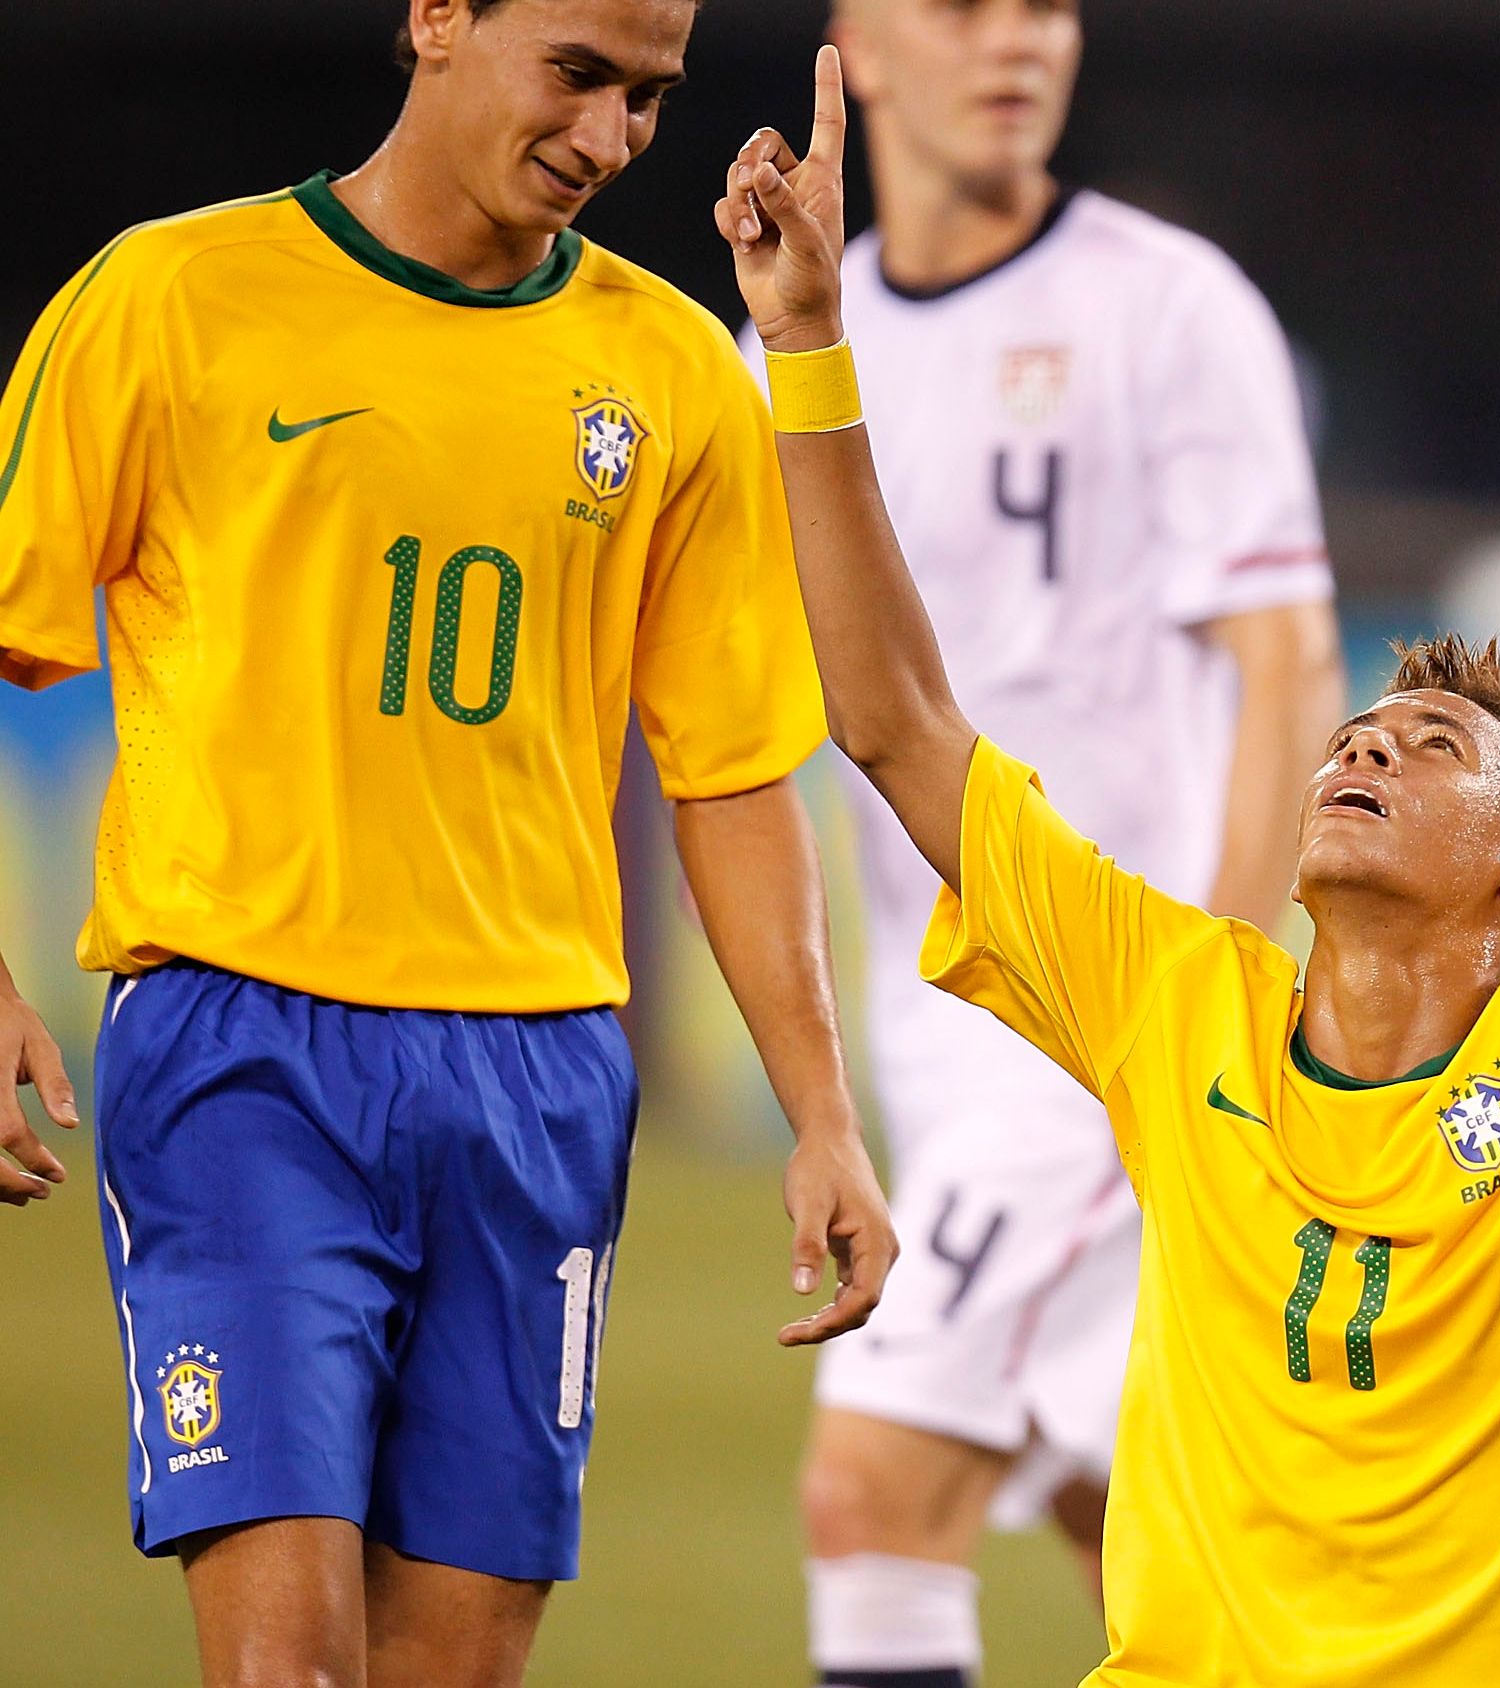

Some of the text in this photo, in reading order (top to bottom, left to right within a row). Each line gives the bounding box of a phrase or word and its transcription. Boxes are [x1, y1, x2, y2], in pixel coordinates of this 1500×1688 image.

[599, 438, 622, 453] CBF
[991, 445, 1060, 585] 4
[379, 534, 523, 725] 10
[1465, 1109, 1493, 1130] CBF
[929, 1188, 1009, 1320] 4
[1284, 1217, 1392, 1391] 11
[179, 1395, 199, 1408] CBF
[168, 1446, 229, 1473] BRASIL
